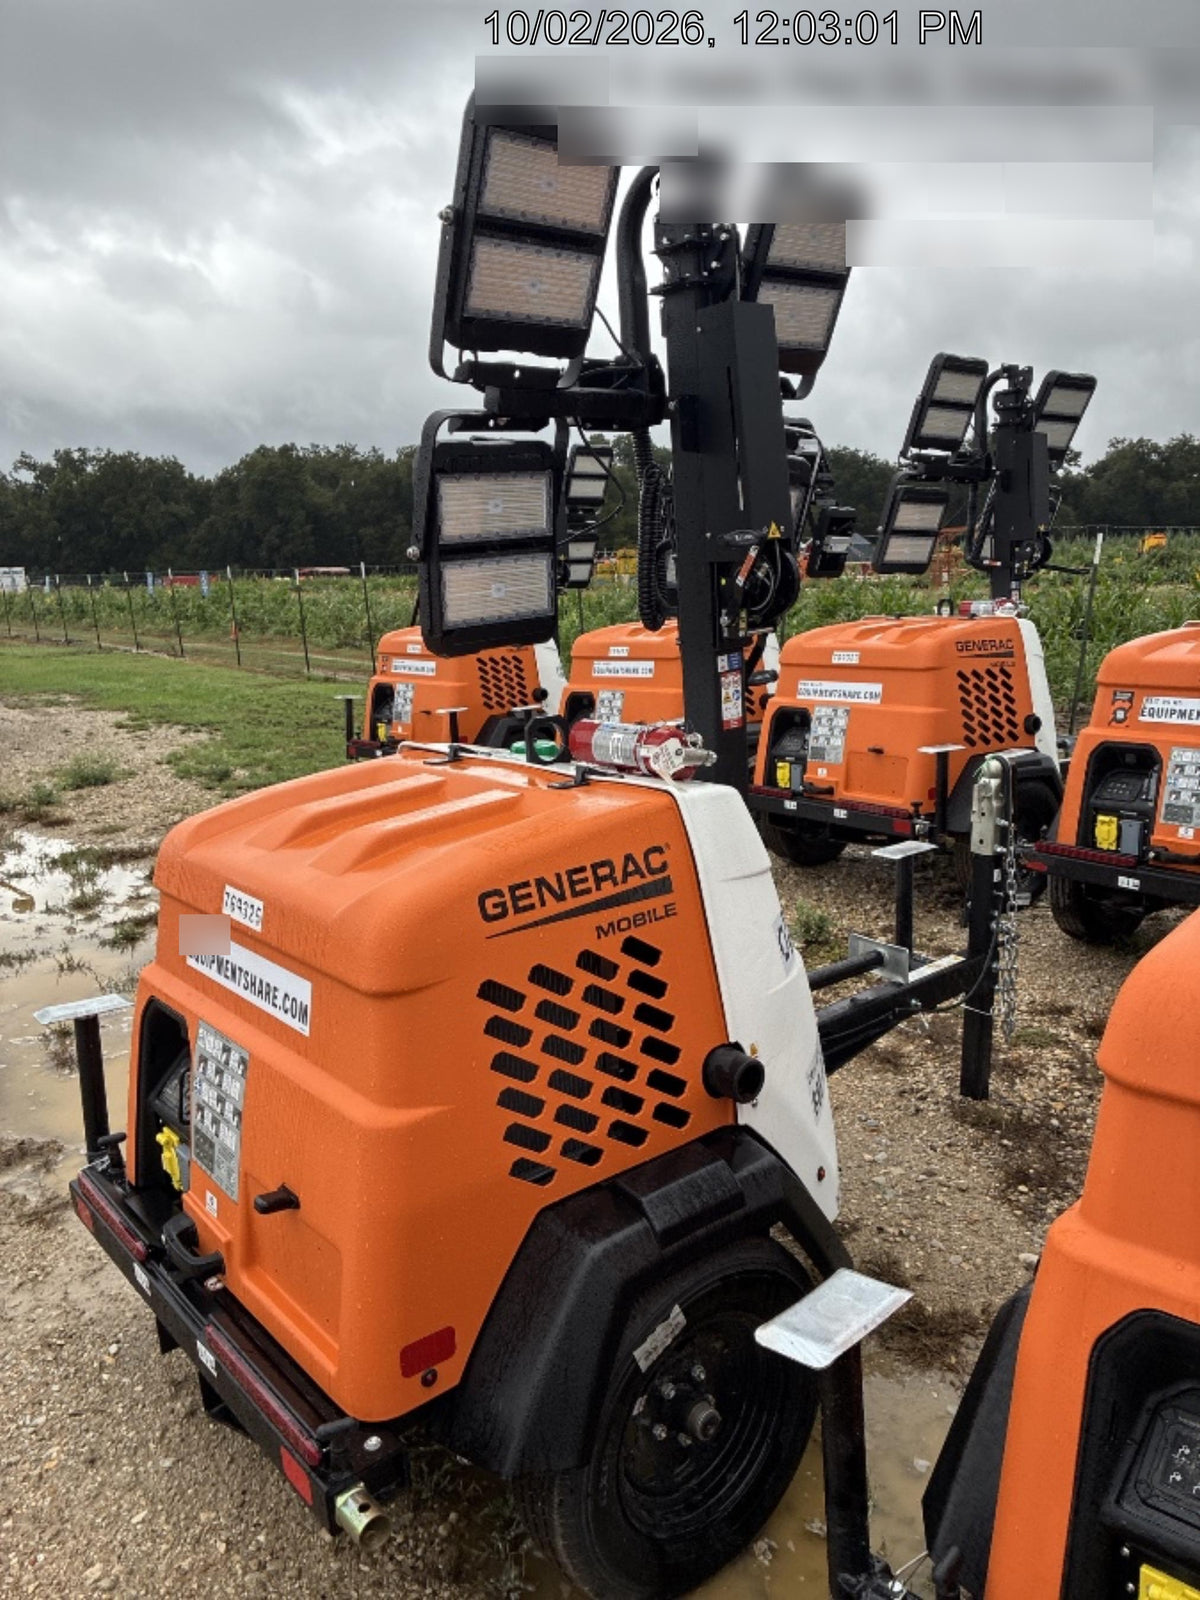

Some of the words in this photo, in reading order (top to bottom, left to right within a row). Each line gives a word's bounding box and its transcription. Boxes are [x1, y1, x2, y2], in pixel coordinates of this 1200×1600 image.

[955, 638, 1014, 652] GENERAC
[478, 845, 669, 923] GENERAC
[595, 902, 678, 940] MOBILE
